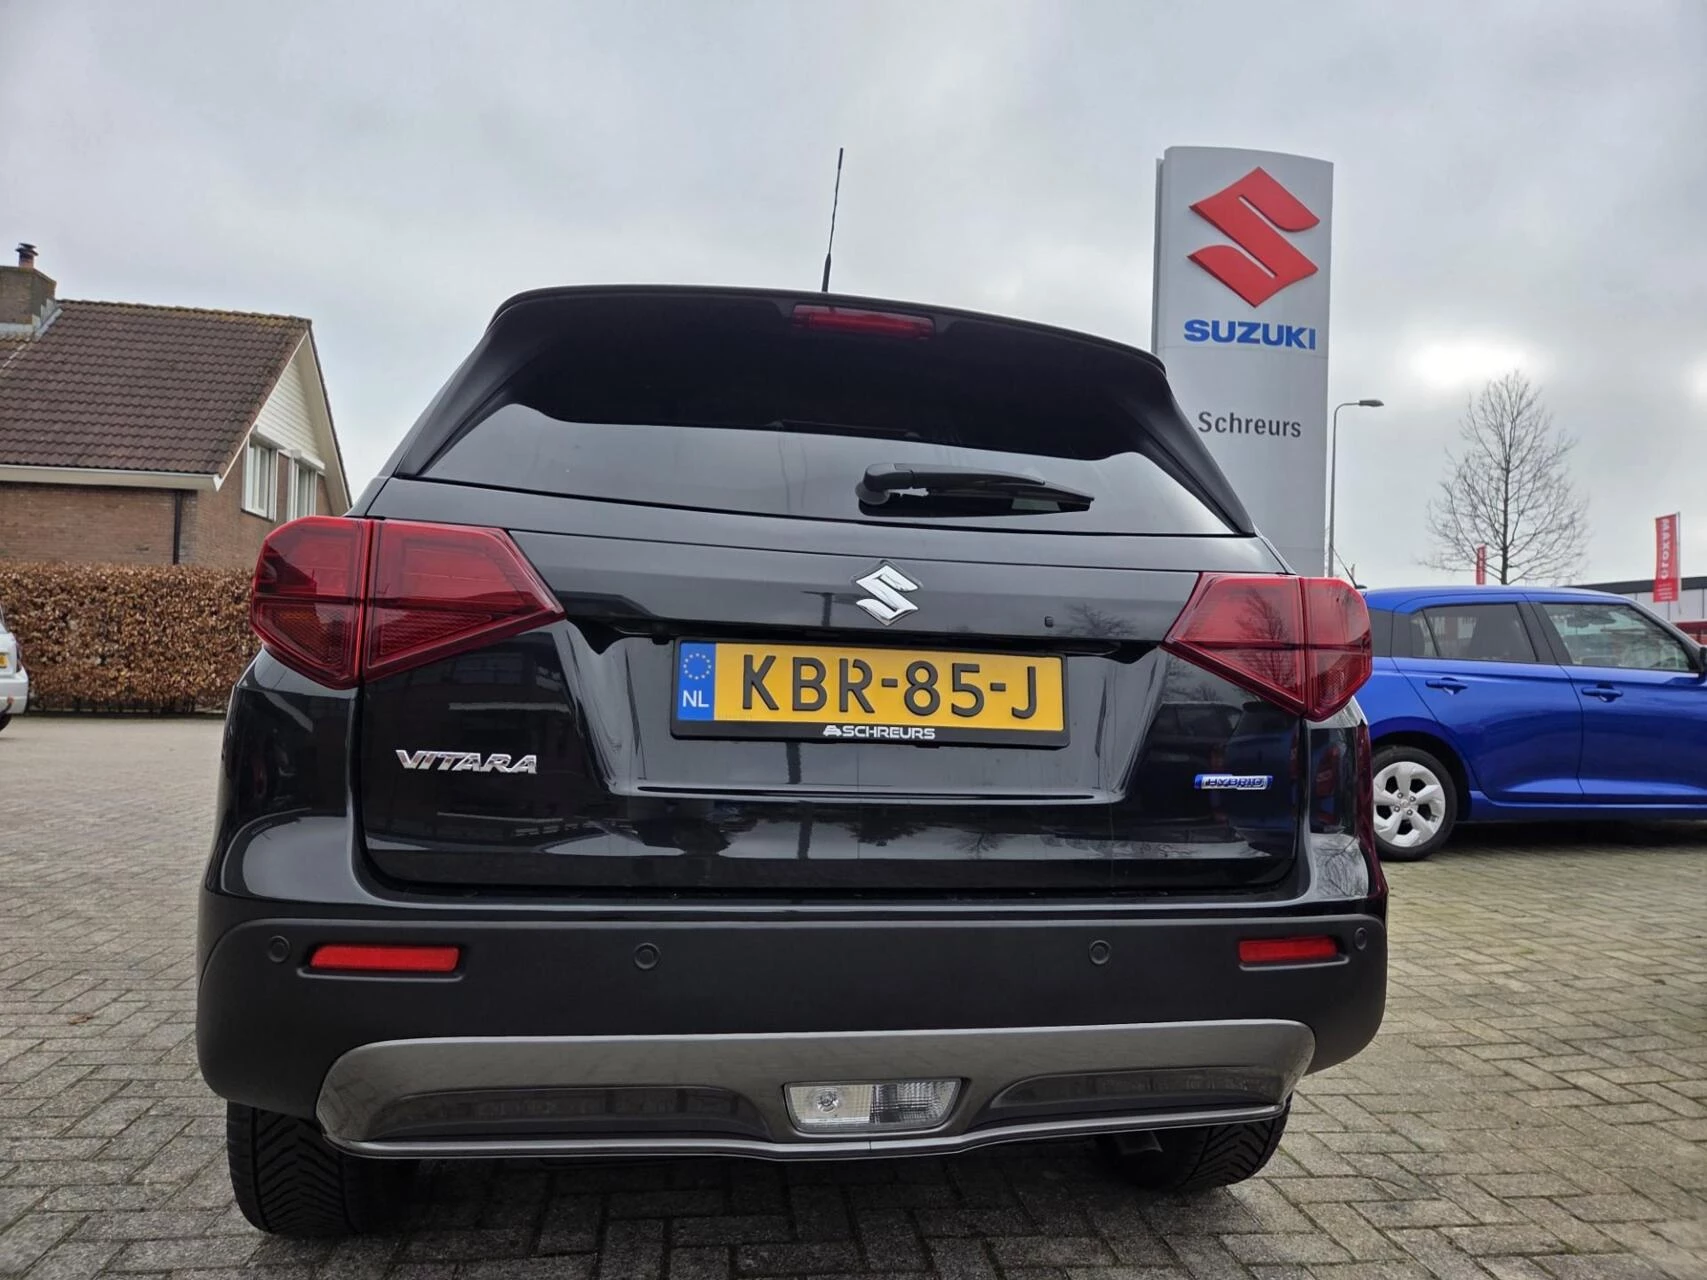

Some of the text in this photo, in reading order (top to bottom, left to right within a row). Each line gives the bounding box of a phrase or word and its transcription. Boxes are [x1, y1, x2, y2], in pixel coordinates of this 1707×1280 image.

[1184, 319, 1316, 350] SUZUKI
[1198, 411, 1302, 438] Schreurs
[682, 690, 709, 708] NL
[742, 654, 1038, 720] KBR-85-J
[842, 725, 936, 740] SCHREURS
[396, 750, 537, 774] VITARA
